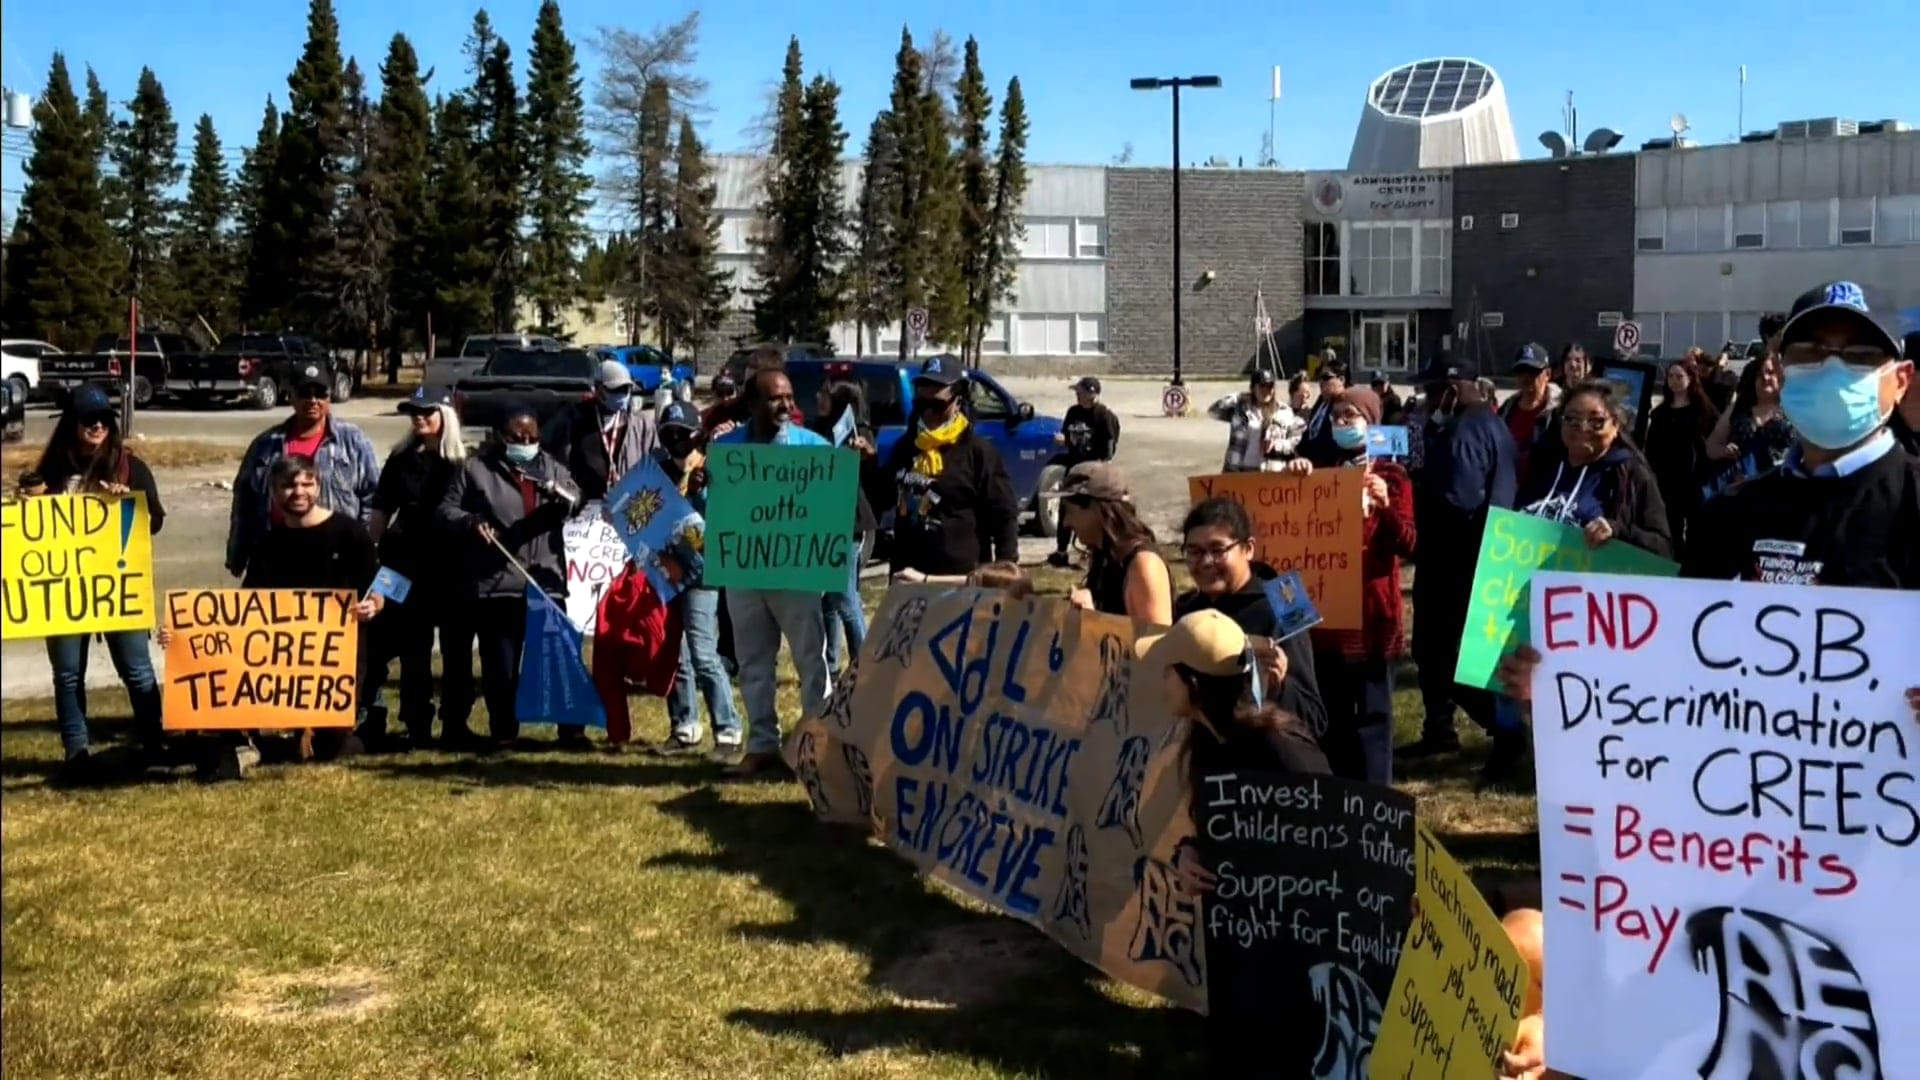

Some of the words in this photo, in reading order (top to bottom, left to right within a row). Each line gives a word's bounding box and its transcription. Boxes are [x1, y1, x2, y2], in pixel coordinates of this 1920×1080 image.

[1353, 174, 1450, 186] ADMINISTRATIVE
[1378, 185, 1426, 195] CENTER
[725, 450, 835, 494] Straight
[1313, 473, 1341, 513] put
[750, 494, 808, 523] outta
[1306, 508, 1343, 539] first
[20, 546, 97, 578] our
[567, 558, 617, 583] NO
[718, 530, 848, 570] FUNDING
[2, 572, 144, 624] UTURE
[168, 590, 354, 630] EQUALITY
[189, 631, 233, 660] FOR
[243, 630, 345, 668] CREE
[1544, 585, 1659, 654] END
[1691, 600, 1880, 692] C.S.B.
[174, 669, 356, 713] TEACHERS
[1555, 671, 1908, 759] Discrimination
[890, 690, 965, 775] ON
[972, 711, 1081, 818] STRIKE
[896, 775, 948, 852] EN
[1204, 772, 1323, 811] Invest
[1343, 790, 1364, 817] in
[1372, 801, 1412, 830] our
[1595, 735, 1670, 783] for
[1692, 748, 1920, 848] CREES
[1206, 809, 1350, 850] Children's
[1358, 823, 1415, 876] future
[1614, 804, 1859, 896] Benefits
[1215, 860, 1344, 912] Support
[1356, 886, 1395, 917] our
[1208, 904, 1282, 949] fight
[1289, 908, 1330, 946] for
[1337, 911, 1402, 971] Equalit
[1418, 829, 1481, 972] Teaching
[1484, 946, 1521, 1019] made
[1399, 977, 1456, 1080] Support
[1442, 962, 1465, 1001] job
[1461, 996, 1504, 1069] possibl
